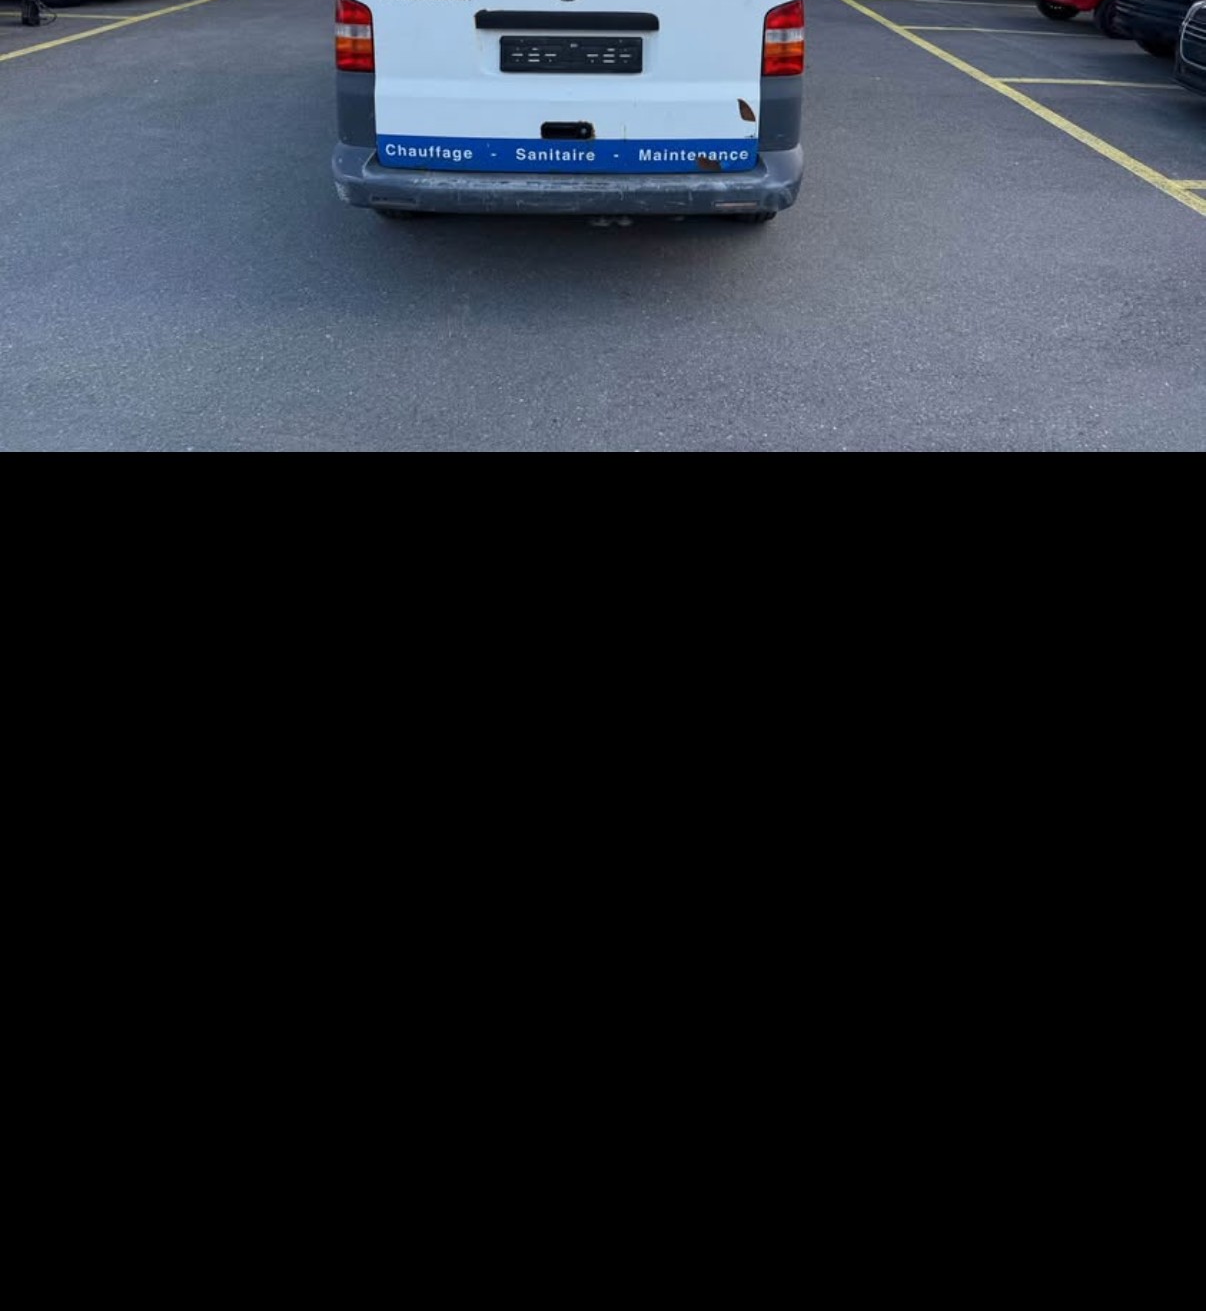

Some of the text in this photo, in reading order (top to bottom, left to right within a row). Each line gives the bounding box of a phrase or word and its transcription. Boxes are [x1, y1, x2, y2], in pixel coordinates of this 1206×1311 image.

[385, 143, 473, 162] Chauffage
[515, 148, 596, 161] Sanitaire
[639, 148, 749, 161] Maintenance
